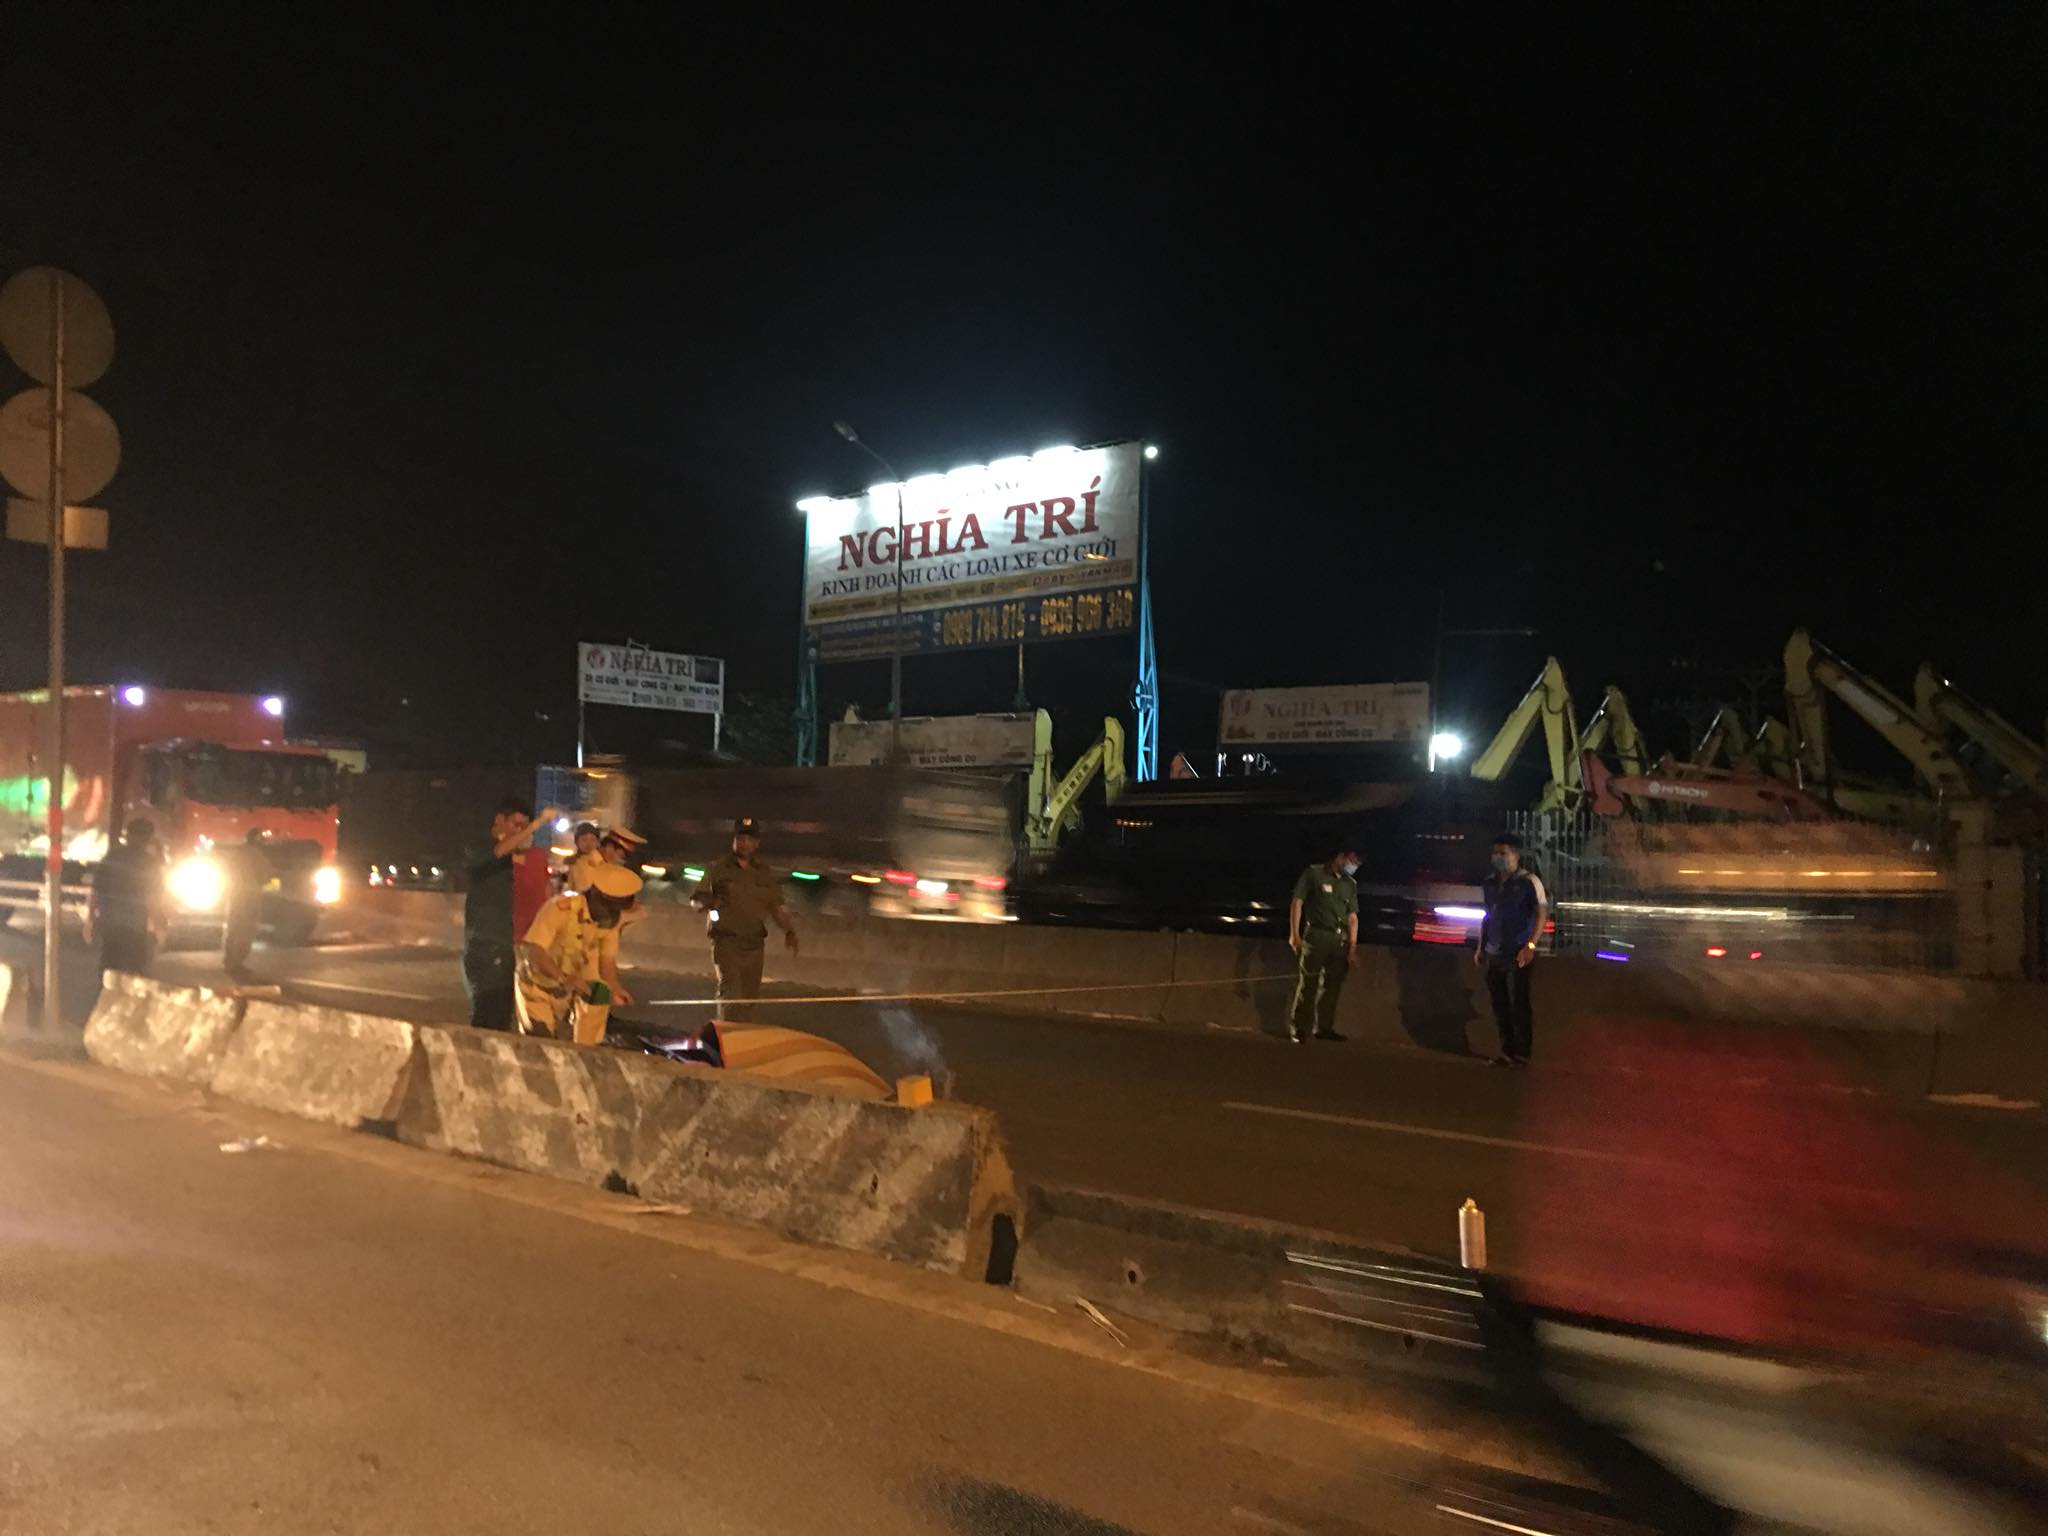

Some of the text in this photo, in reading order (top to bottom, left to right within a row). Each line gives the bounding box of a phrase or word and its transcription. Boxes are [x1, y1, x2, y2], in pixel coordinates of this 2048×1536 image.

[837, 475, 1102, 571] NGHĨA TRÍ
[821, 575, 860, 597] KINH
[865, 567, 922, 589] DOANH
[927, 560, 961, 581] CÁC
[966, 552, 1012, 577] LOẠI
[1014, 550, 1038, 570] XE
